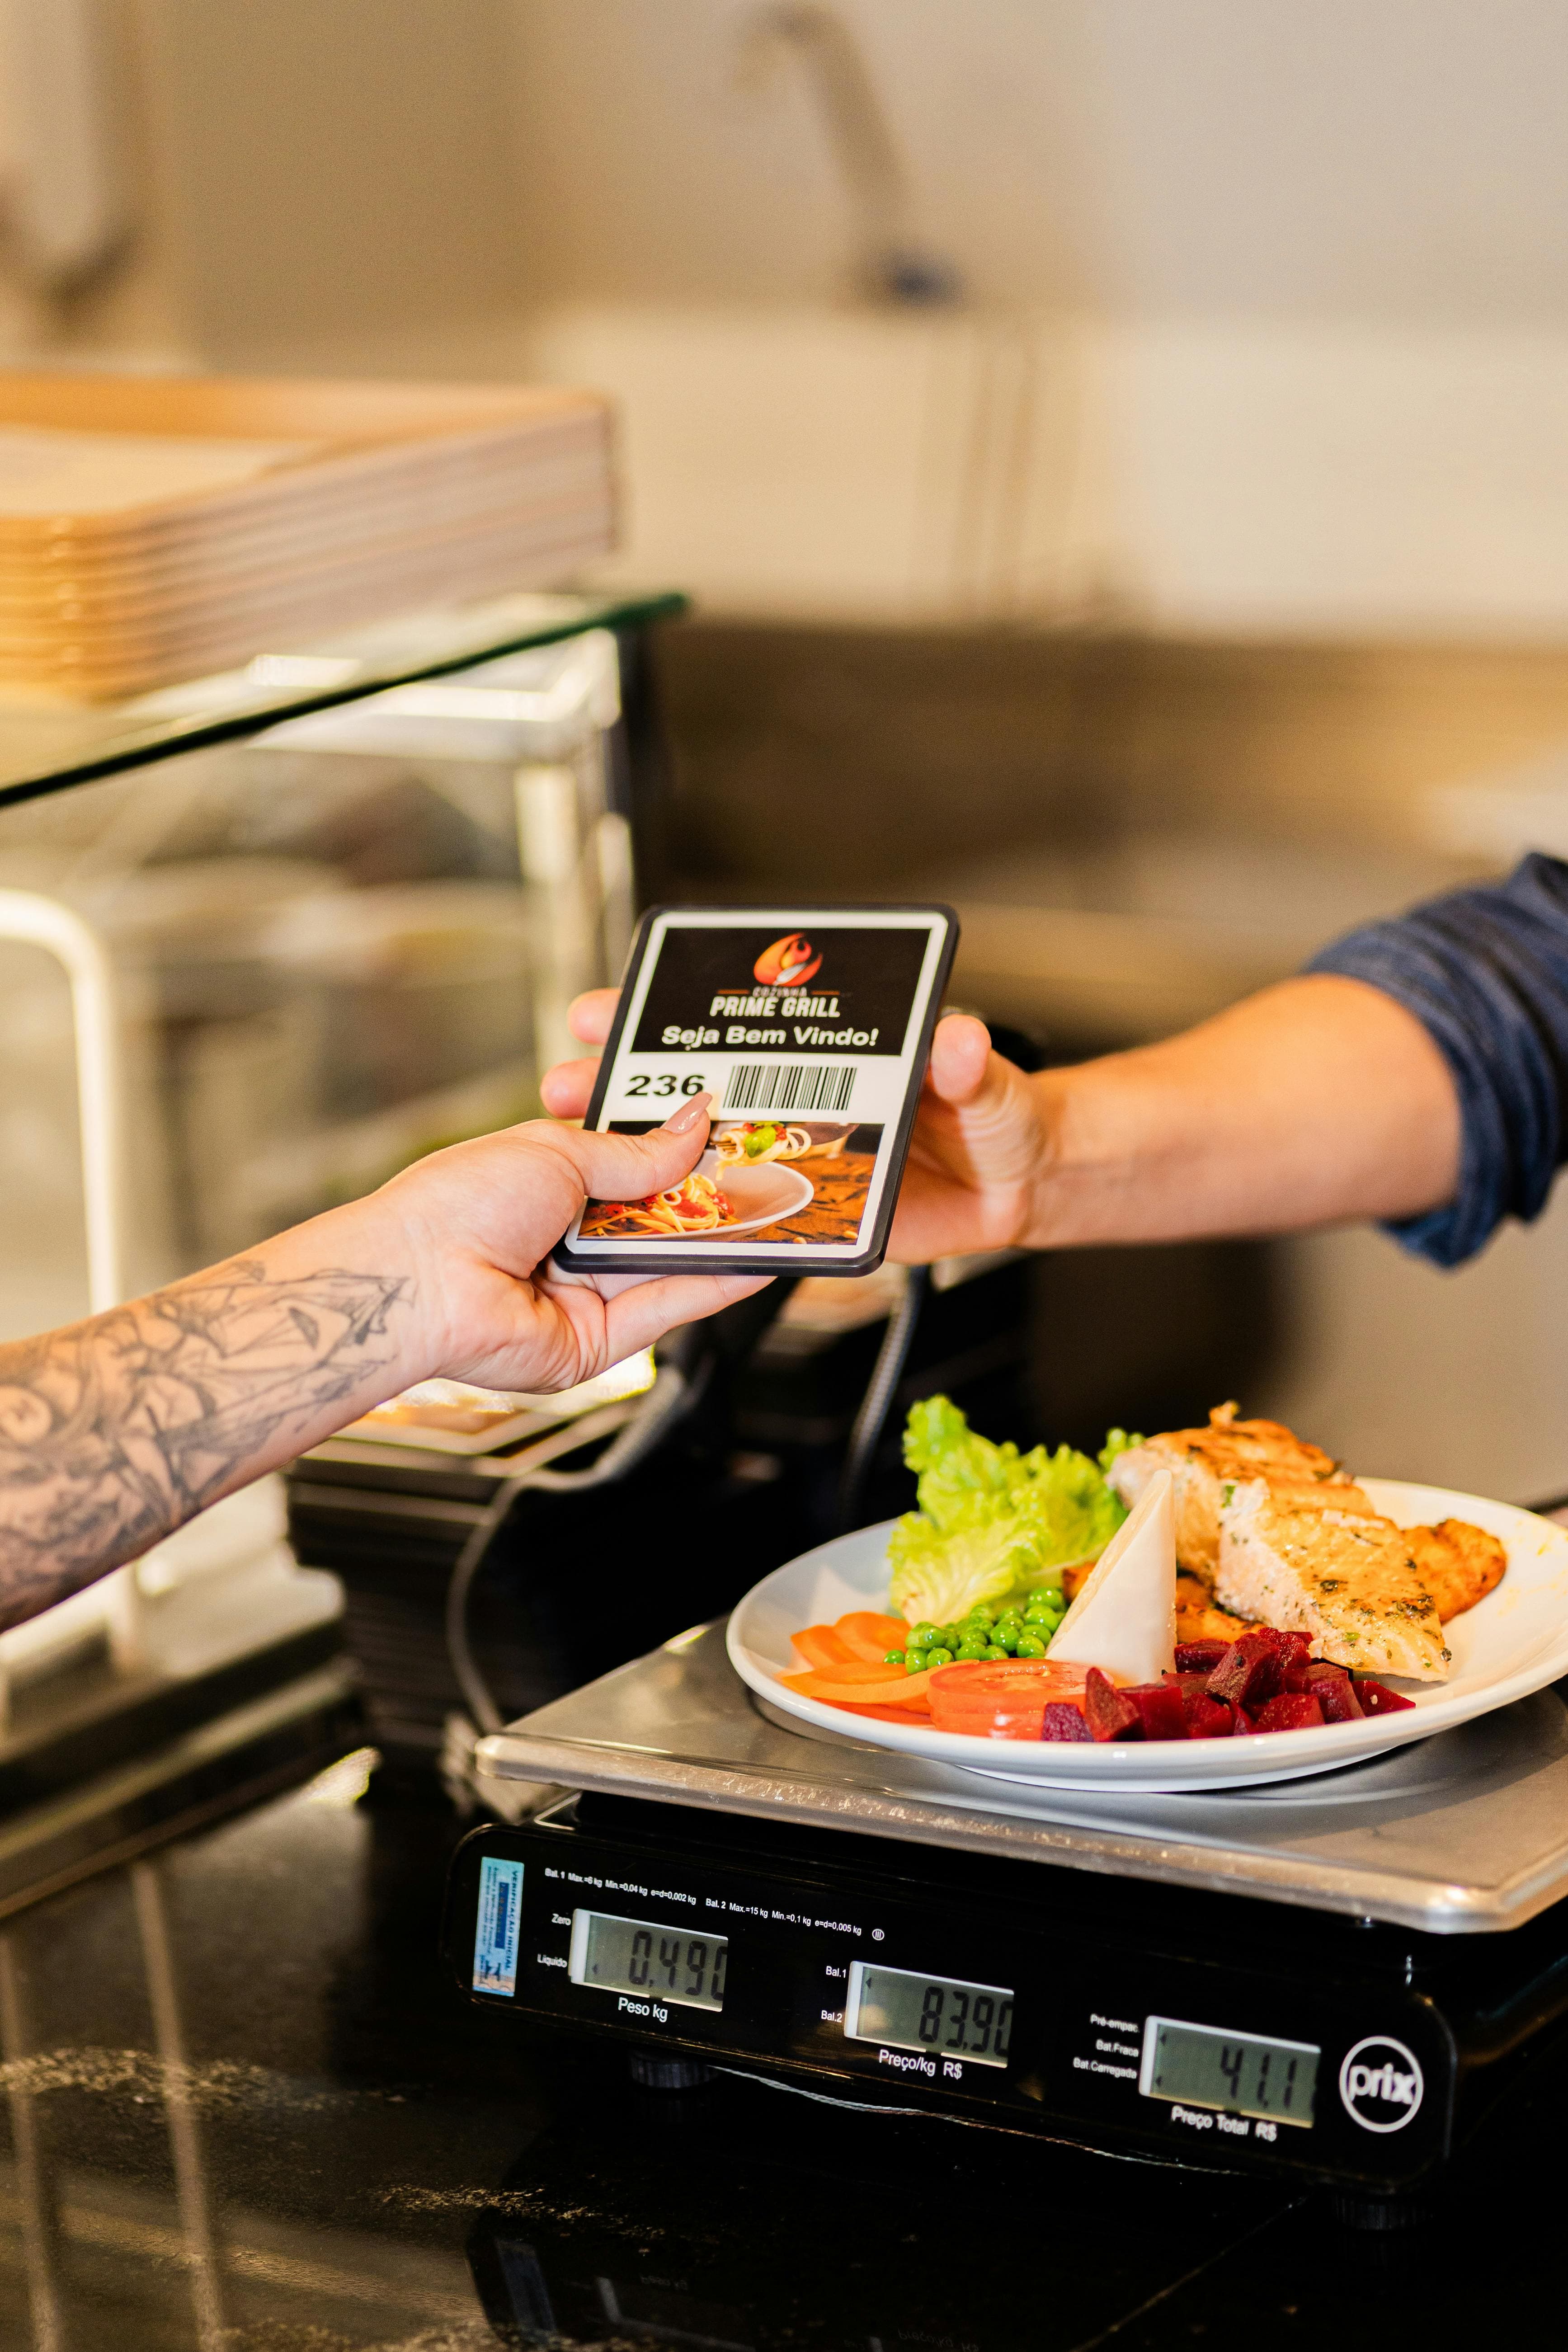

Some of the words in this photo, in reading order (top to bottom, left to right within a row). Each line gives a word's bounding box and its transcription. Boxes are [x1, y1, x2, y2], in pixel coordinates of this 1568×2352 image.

[710, 996, 779, 1017] PRIME
[781, 997, 841, 1018] GRILL
[661, 1025, 720, 1048] Seja
[725, 1025, 786, 1044] Bem
[793, 1026, 879, 1046] Vindo!
[625, 1074, 706, 1097] 236
[551, 1913, 571, 1926] Zero
[721, 1901, 726, 1909] 2
[760, 1908, 768, 1919] kg
[803, 1916, 811, 1927] kg
[853, 1925, 862, 1936] kg
[826, 1966, 847, 1978] Bal.1
[618, 1997, 650, 2016] Peso
[652, 2004, 668, 2023] kg
[821, 2010, 843, 2023] Bal.2
[878, 2049, 936, 2076] Preço/kg
[943, 2062, 963, 2080] R$
[1349, 2063, 1415, 2105] prix
[1171, 2105, 1212, 2130] Preço
[1216, 2113, 1249, 2136] Total
[1255, 2121, 1278, 2142] R$
